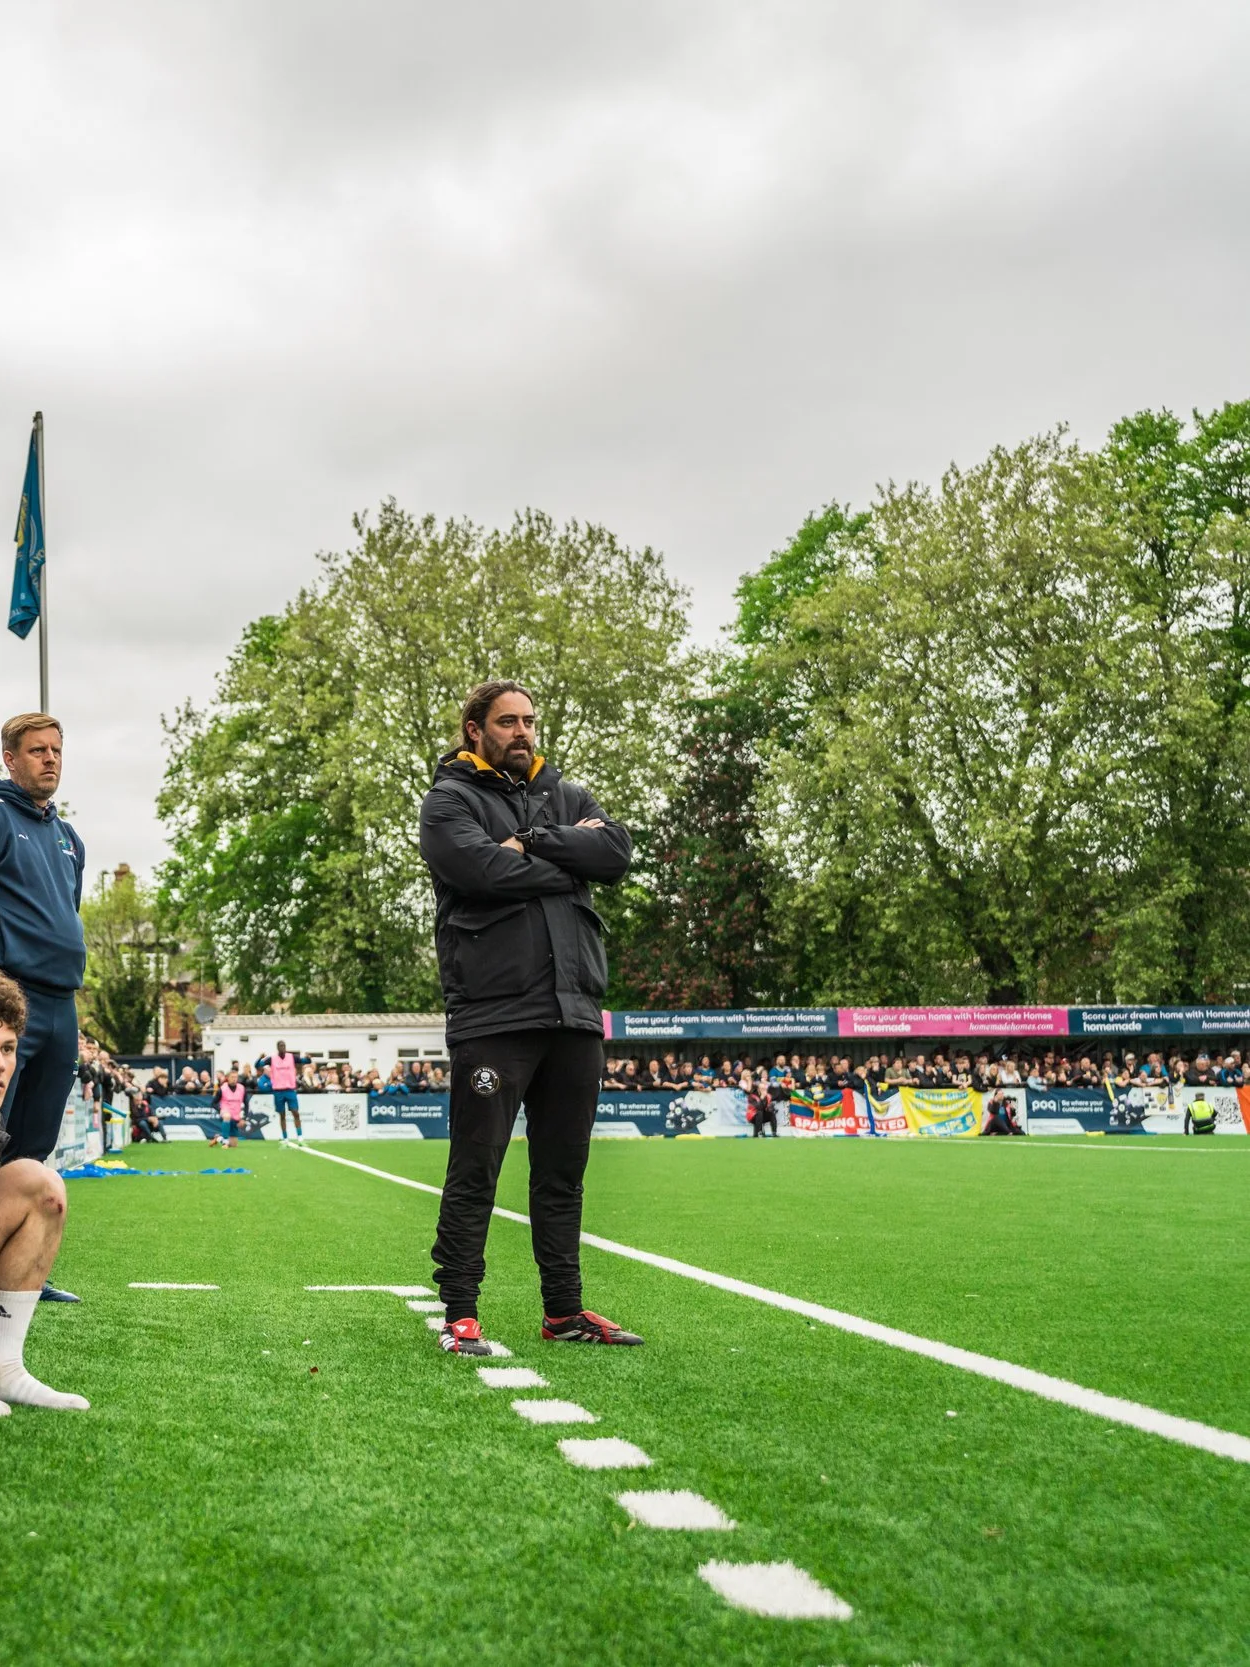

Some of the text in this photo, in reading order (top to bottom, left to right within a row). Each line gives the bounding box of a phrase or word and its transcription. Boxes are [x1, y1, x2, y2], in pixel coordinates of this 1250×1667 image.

[625, 1014, 825, 1025] Score your dream home with Homemade Homes
[853, 1012, 1052, 1023] Score your dream home with Homemade Homes
[1082, 1012, 1106, 1021] Score
[1108, 1013, 1128, 1022] your
[1130, 1011, 1157, 1020] dream
[1160, 1011, 1183, 1019] home
[1185, 1011, 1204, 1019] with
[625, 1025, 684, 1036] homemade
[742, 1024, 827, 1033] homemadehomes.com
[853, 1023, 911, 1033] homemade
[969, 1022, 1054, 1031] homemadehomes.com
[1083, 1021, 1142, 1032] homemade
[428, 1105, 443, 1113] your
[597, 1103, 615, 1115] oq
[646, 1103, 661, 1111] your
[1032, 1100, 1057, 1112] poq
[1090, 1100, 1104, 1108] your
[371, 1105, 397, 1117] poq
[400, 1111, 432, 1119] customers
[619, 1109, 650, 1117] customers
[794, 1117, 856, 1130] SPALDING
